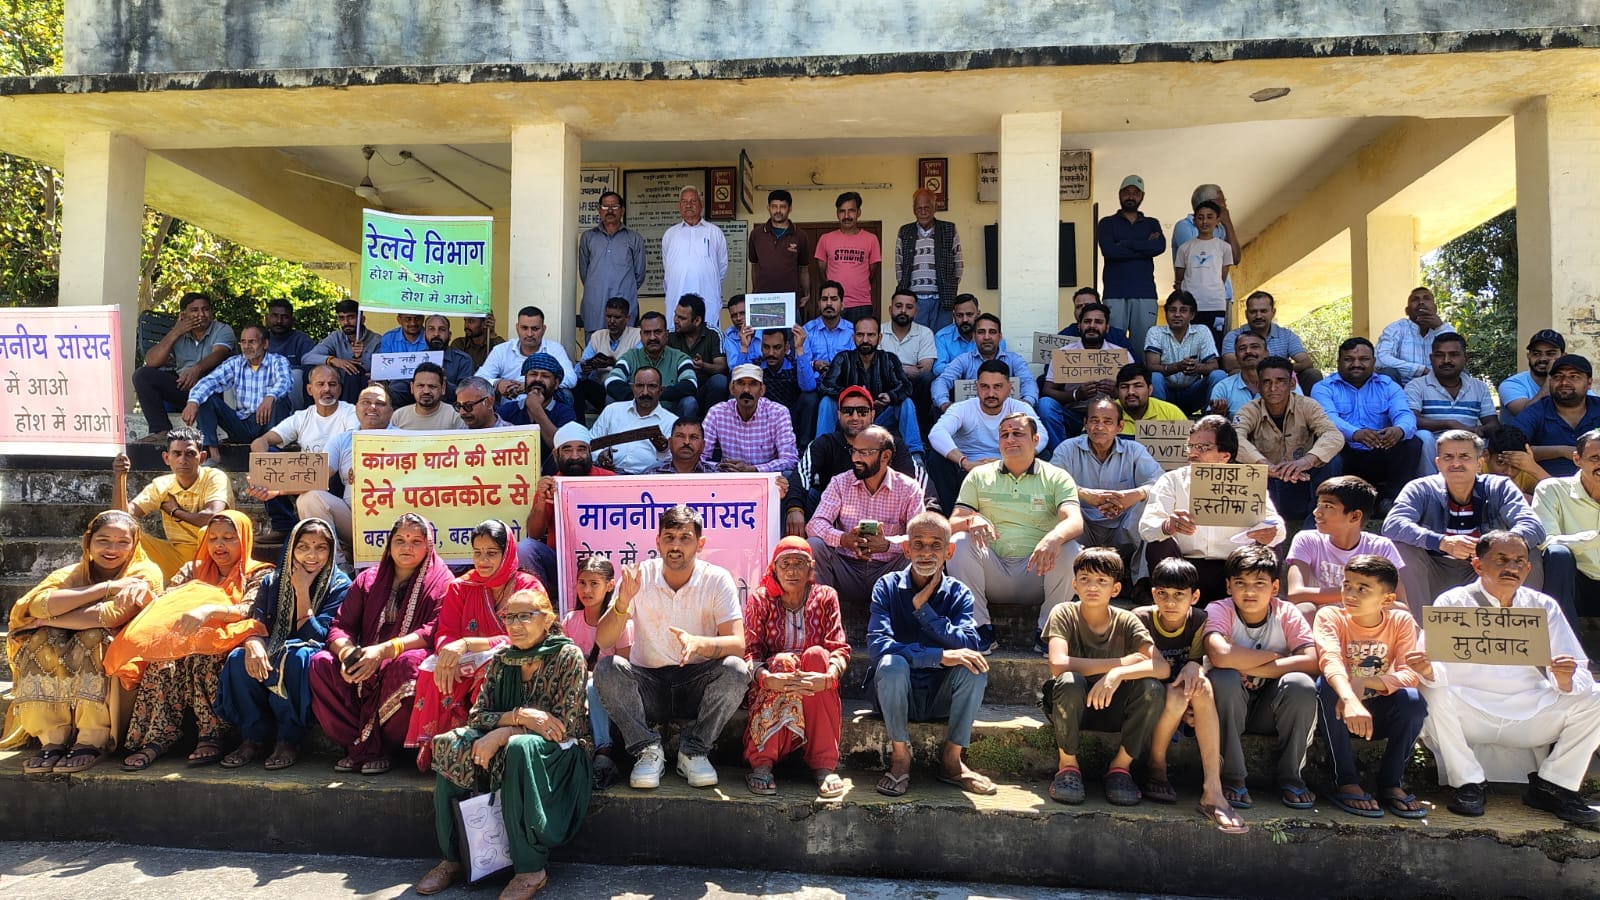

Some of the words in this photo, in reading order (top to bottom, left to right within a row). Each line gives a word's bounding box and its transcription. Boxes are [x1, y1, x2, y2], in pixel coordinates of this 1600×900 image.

[366, 223, 416, 262] रेलवे
[424, 230, 485, 265] विभाग
[369, 265, 393, 281] होश
[398, 267, 408, 282] में
[413, 271, 444, 285] आओ
[401, 288, 423, 302] होश
[428, 291, 439, 303] में
[0, 323, 48, 359] ननीय
[54, 325, 111, 360] सांसद
[4, 371, 20, 396] में
[28, 371, 69, 396] आओ
[15, 407, 46, 432] होश
[52, 407, 66, 432] में
[1139, 424, 1157, 437] NO
[1161, 425, 1190, 436] RAIL
[255, 457, 283, 467] काम
[312, 454, 324, 467] तो
[361, 448, 417, 475] कांगड़ा
[423, 445, 459, 469] घाटी
[464, 444, 486, 467] की
[491, 441, 529, 466] सारी
[1145, 445, 1155, 457] O
[264, 467, 285, 484] वोट
[1195, 465, 1241, 483] कांगड़ा
[1246, 465, 1260, 481] के
[403, 476, 502, 508] पठानकोट
[508, 475, 530, 506] से
[1210, 481, 1248, 496] सांसद
[1251, 493, 1265, 515] दो
[1428, 610, 1471, 628] जम्मू
[1474, 608, 1541, 628] डिवीजन
[1451, 630, 1529, 660] मुर्दाबाद
